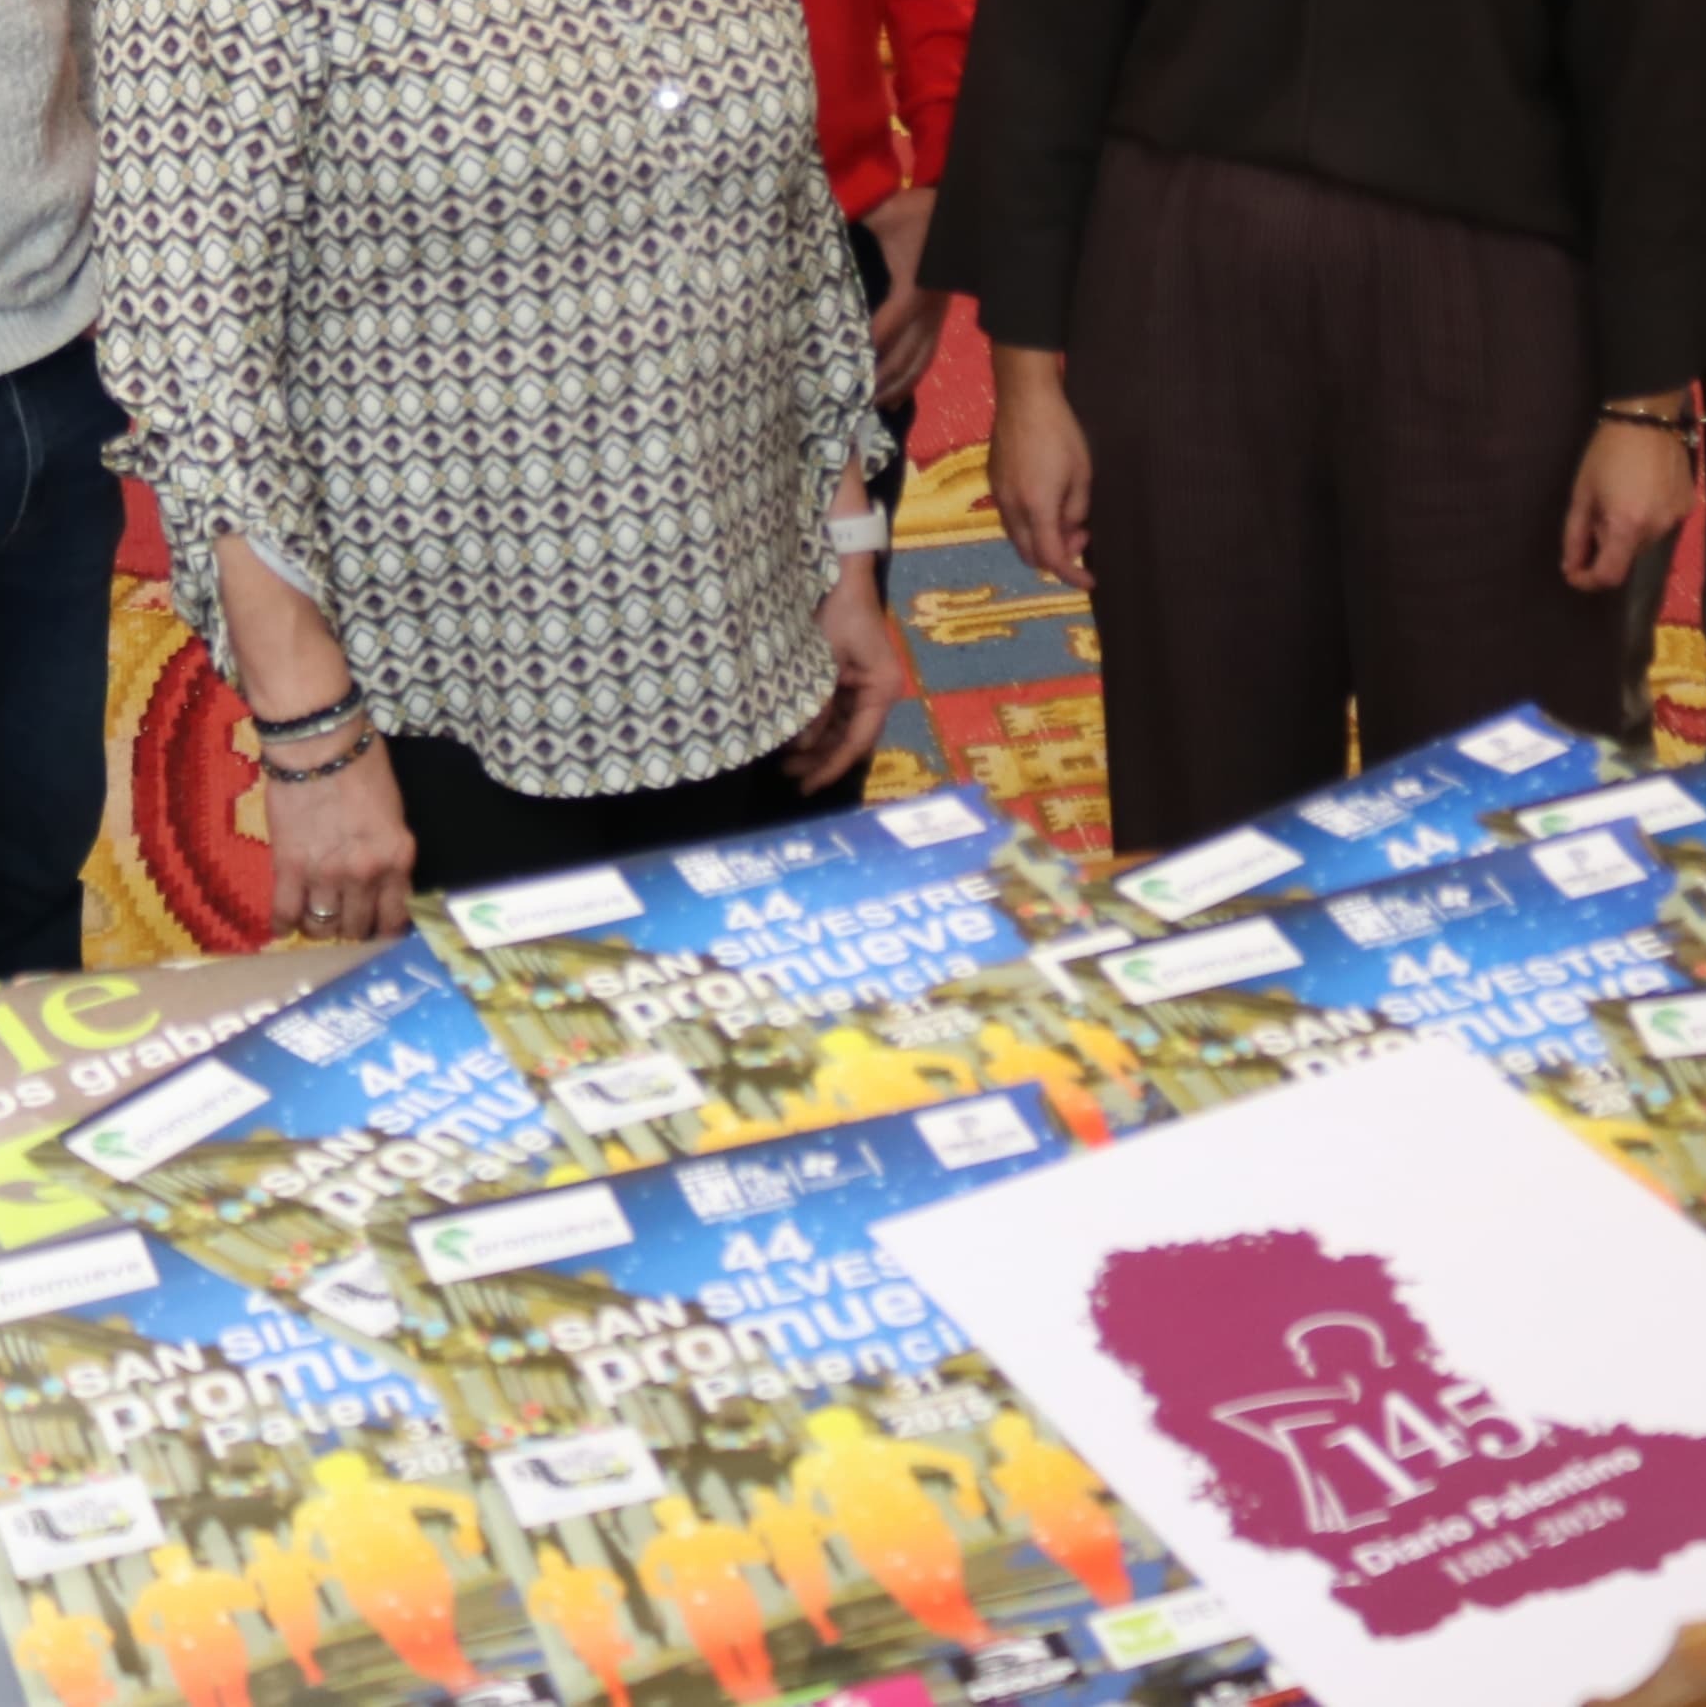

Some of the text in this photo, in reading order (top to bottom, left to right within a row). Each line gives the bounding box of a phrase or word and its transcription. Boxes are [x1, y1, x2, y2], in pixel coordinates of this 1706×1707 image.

[585, 873, 1002, 998] SAN SILVESTRE
[725, 889, 804, 934] 44
[614, 907, 997, 1039] promueve
[717, 954, 979, 1038] Palencia
[1253, 930, 1674, 1057] SAN SILVESTRE
[1387, 943, 1473, 989] 44
[359, 1041, 438, 1098] 44
[260, 1127, 377, 1197] SAN
[367, 1038, 510, 1137] SILVE
[719, 1220, 813, 1273] 44
[548, 1296, 687, 1353] SAN
[577, 1283, 930, 1407] promue
[66, 1341, 206, 1400] SAN
[1326, 1376, 1537, 1503] 145
[1354, 1447, 1643, 1578] Diario Palentino
[1439, 1495, 1627, 1586] 1881-2026
